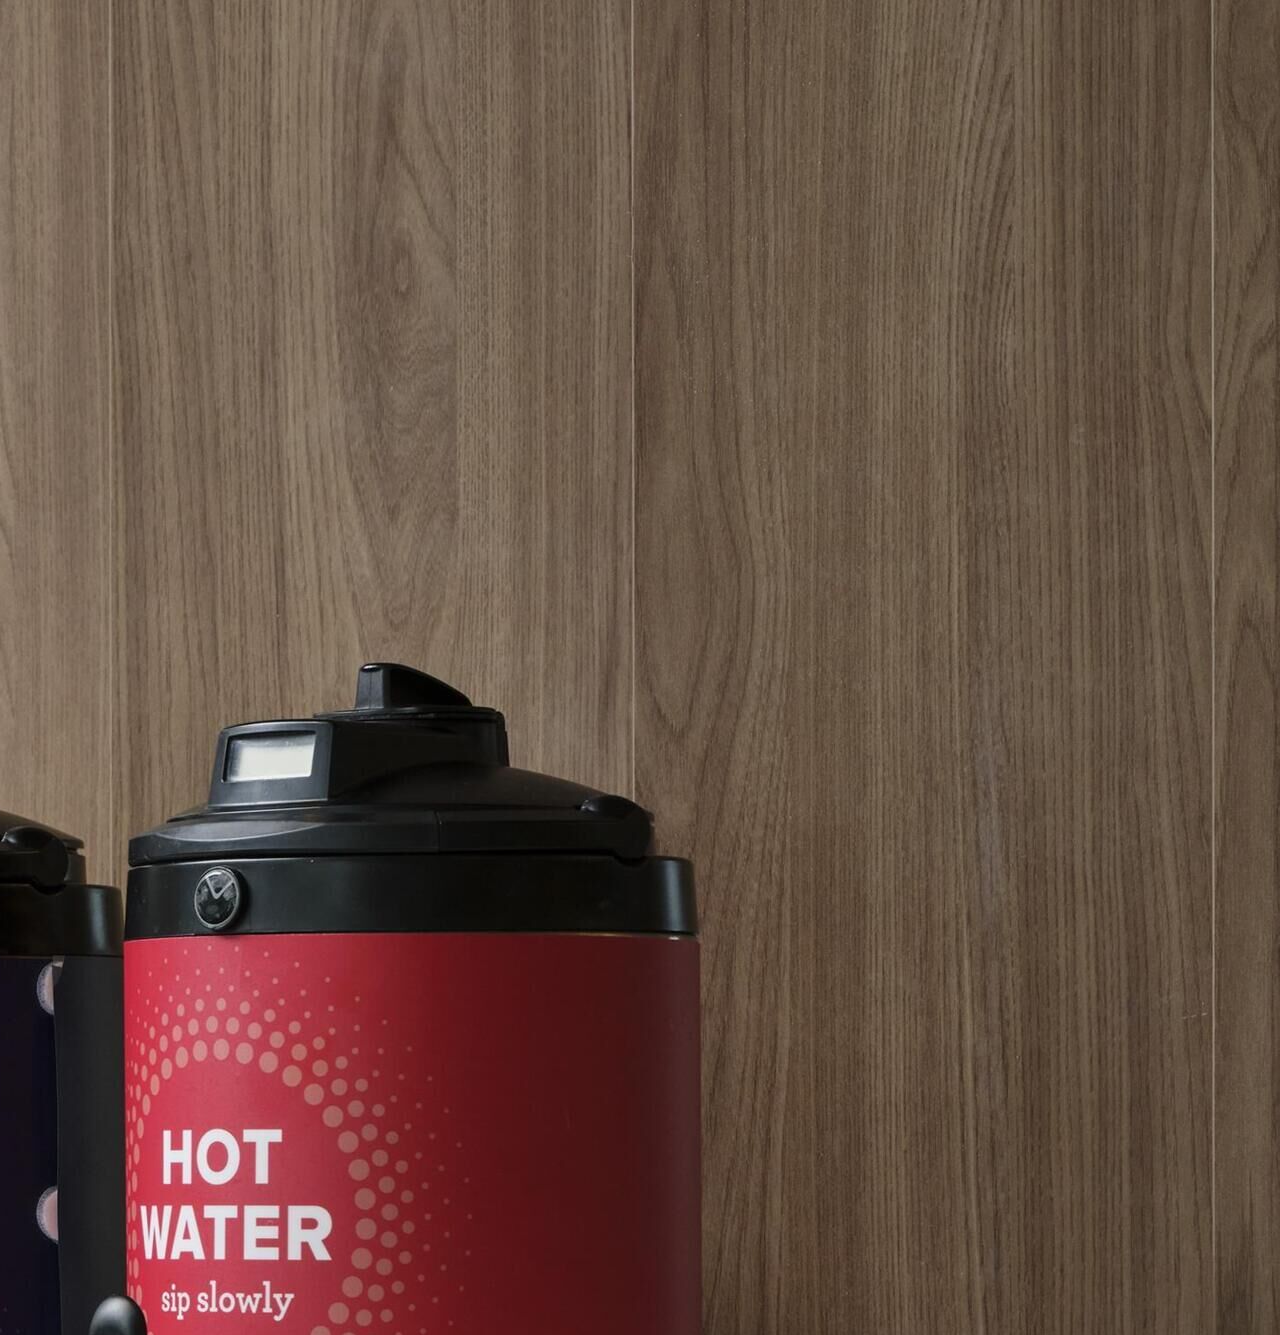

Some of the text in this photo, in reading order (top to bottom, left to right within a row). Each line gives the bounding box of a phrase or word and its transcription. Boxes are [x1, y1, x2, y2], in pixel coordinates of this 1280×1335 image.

[162, 1128, 283, 1185] HOT
[140, 1204, 333, 1261] WATER
[161, 1280, 294, 1321] sip slowly
